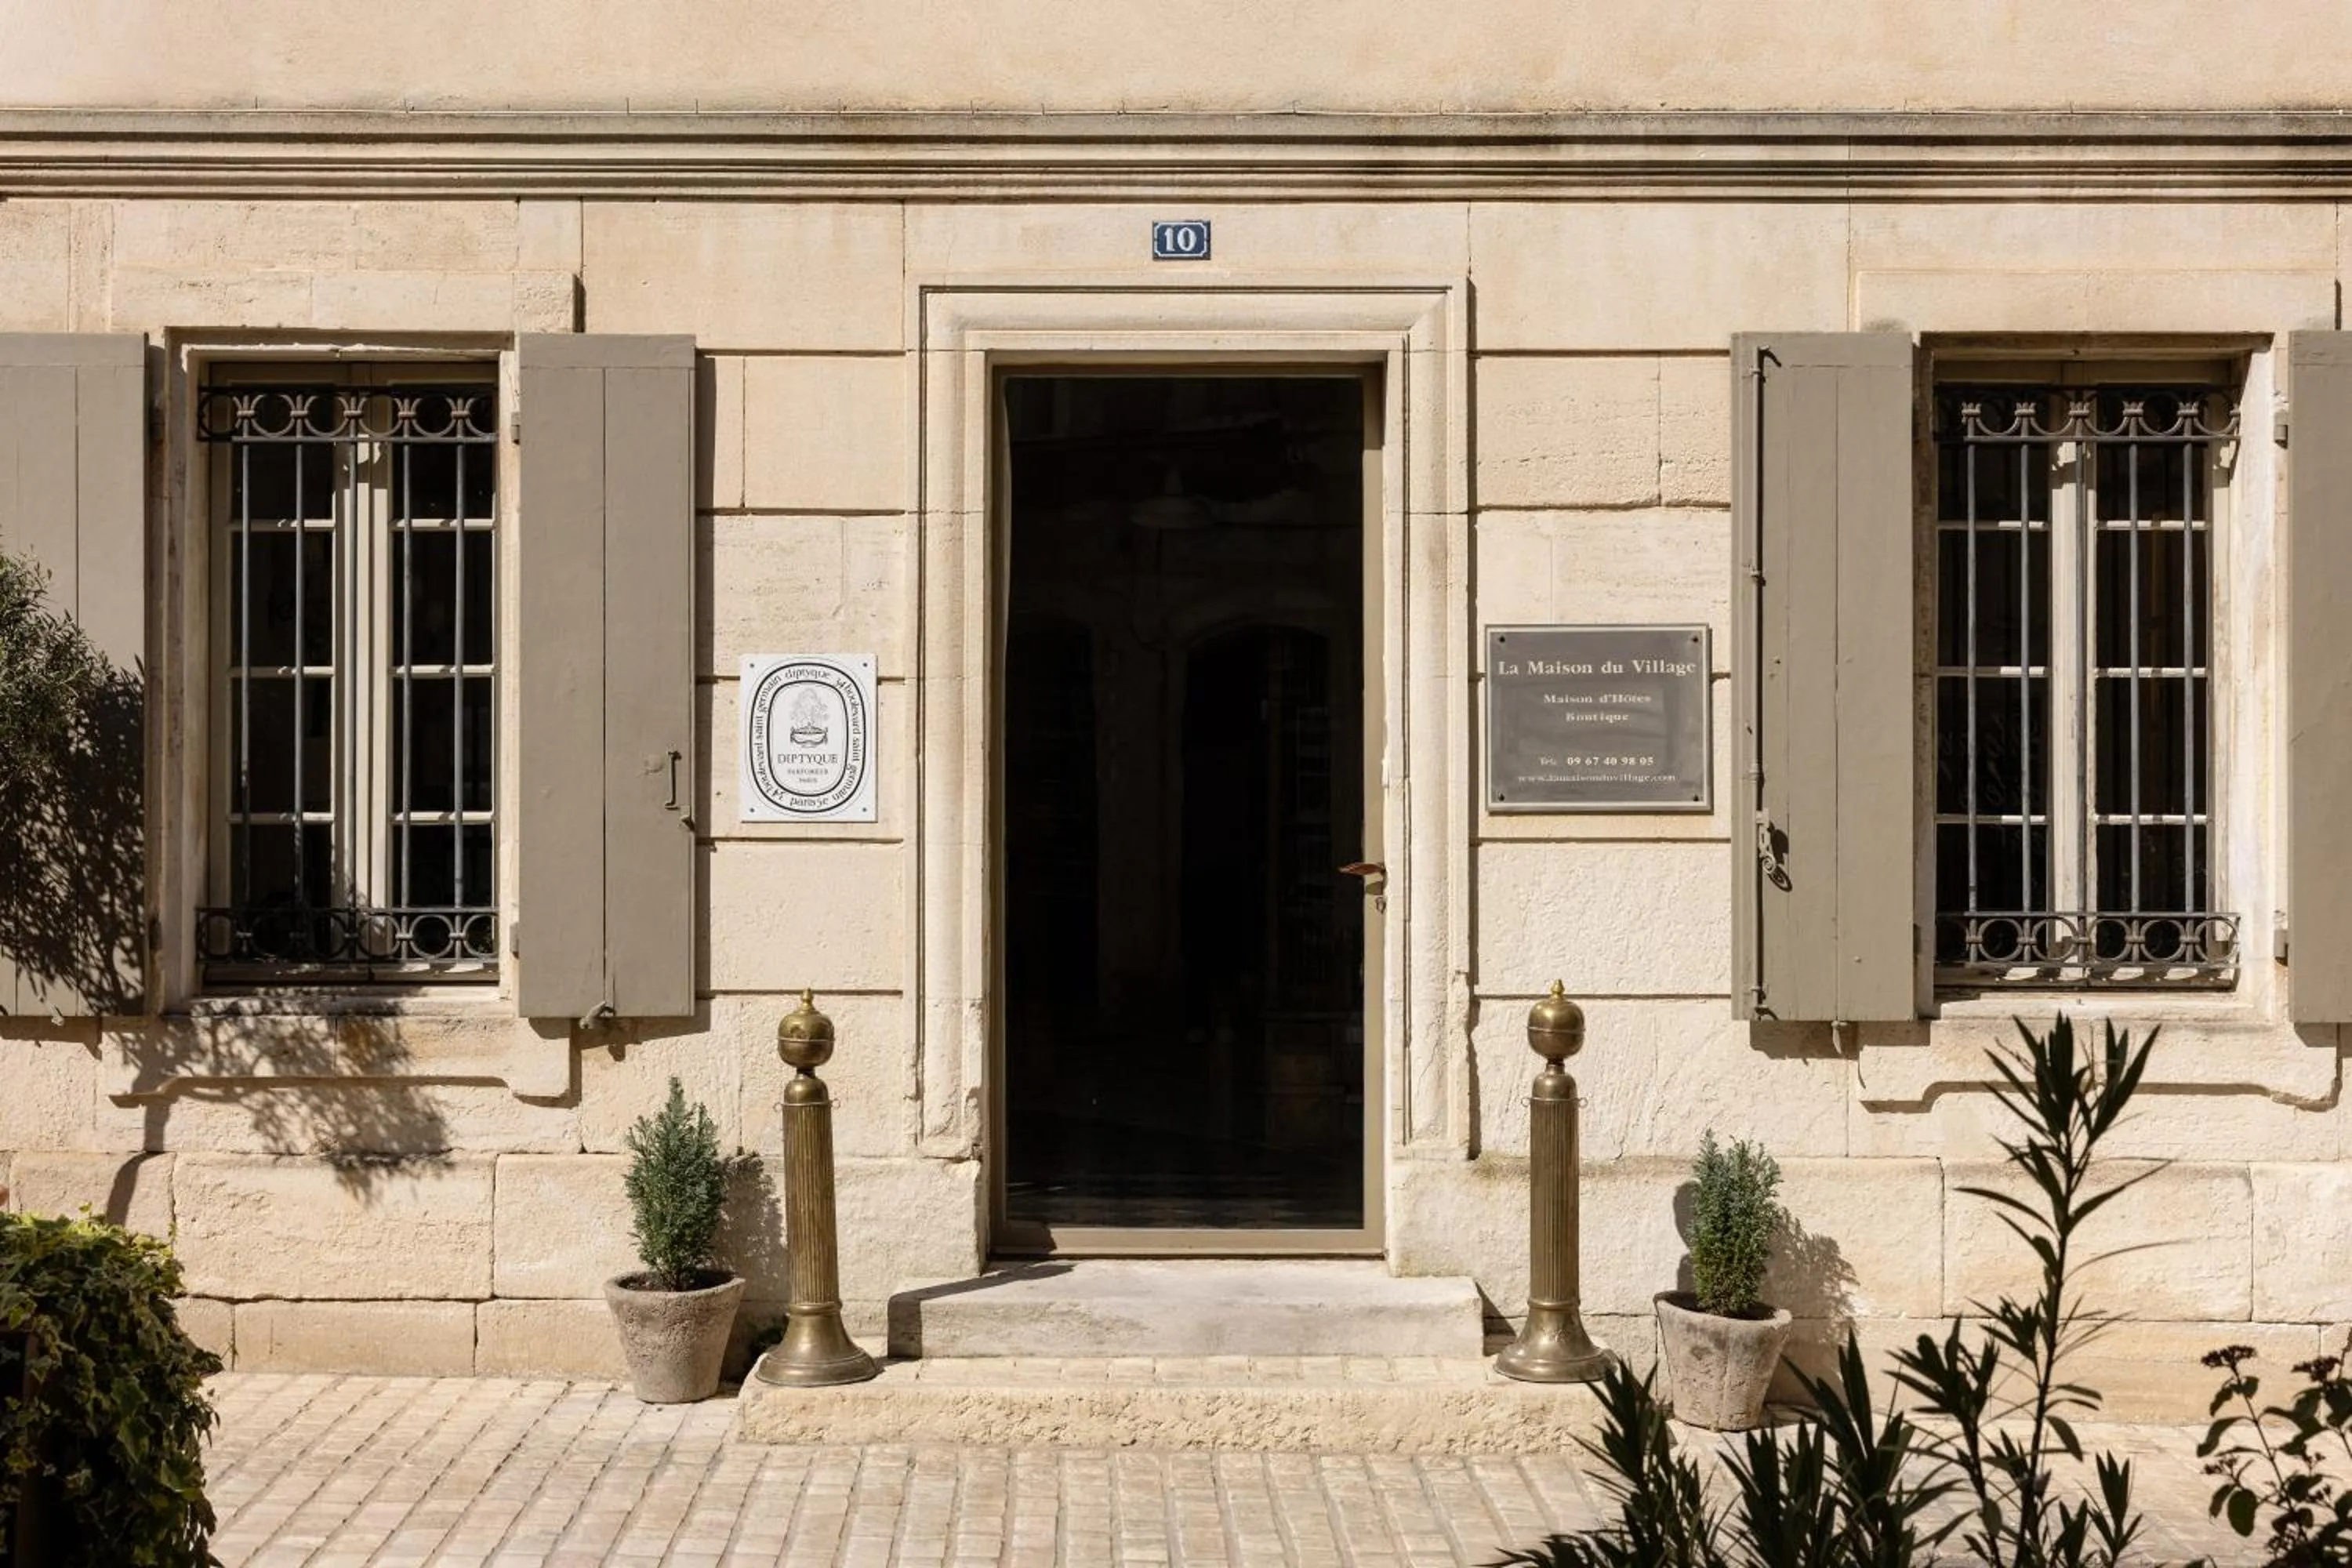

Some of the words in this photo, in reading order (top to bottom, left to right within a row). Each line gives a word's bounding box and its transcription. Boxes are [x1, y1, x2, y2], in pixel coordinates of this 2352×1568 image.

[1164, 227, 1196, 251] 10
[785, 668, 831, 680] diptyque
[1497, 661, 1519, 674] La
[1526, 661, 1592, 674] Maison
[1601, 660, 1624, 674] du
[1632, 659, 1697, 677] Village
[758, 675, 782, 713] germain
[1543, 694, 1592, 703] Maison
[846, 682, 862, 735] boulevard
[1566, 712, 1629, 724] Boutique
[755, 715, 764, 740] saint
[777, 753, 838, 765] DIPTYQUE
[852, 737, 861, 762] saint
[1567, 757, 1581, 765] 09
[1584, 757, 1599, 766] 67
[1639, 757, 1653, 765] 05
[832, 764, 857, 800] germain
